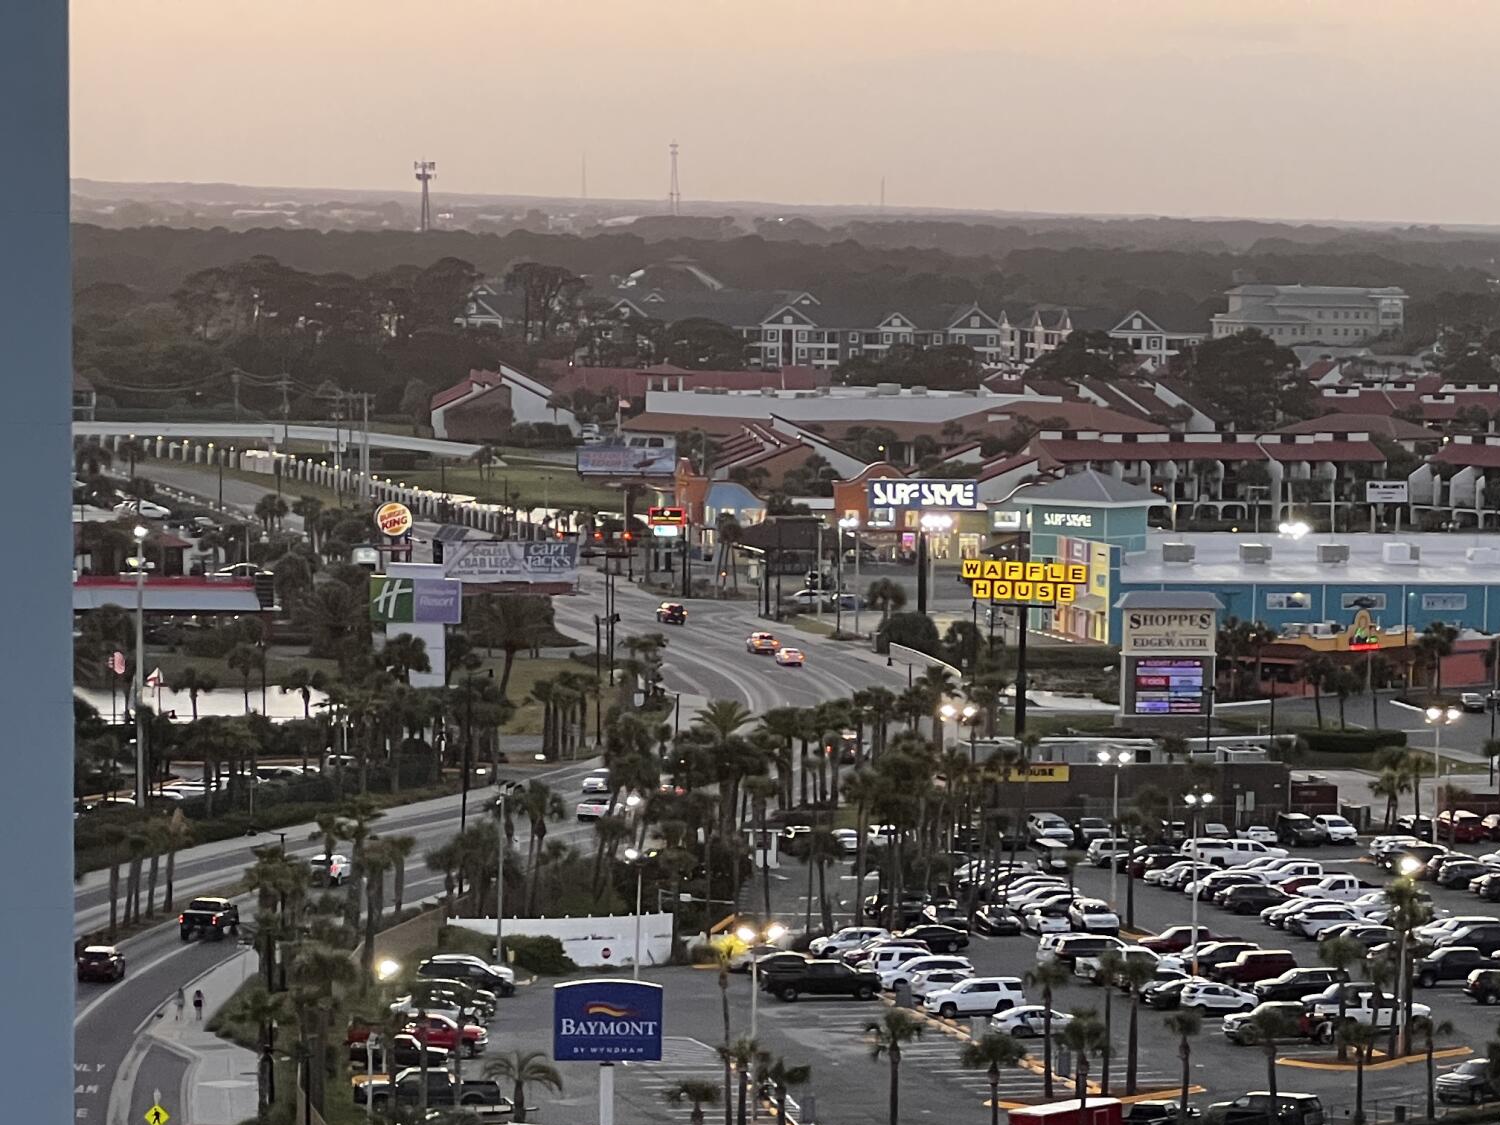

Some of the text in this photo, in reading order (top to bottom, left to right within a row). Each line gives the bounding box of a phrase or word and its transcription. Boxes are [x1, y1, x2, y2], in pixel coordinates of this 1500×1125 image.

[921, 483, 974, 506] STYLE
[382, 516, 408, 530] KING
[965, 563, 1083, 580] WAFFLE
[976, 583, 1071, 598] HOUSE
[1129, 613, 1211, 629] SHOPPES
[1133, 638, 1207, 648] EDGEWATER
[561, 1018, 657, 1036] BAYMONT
